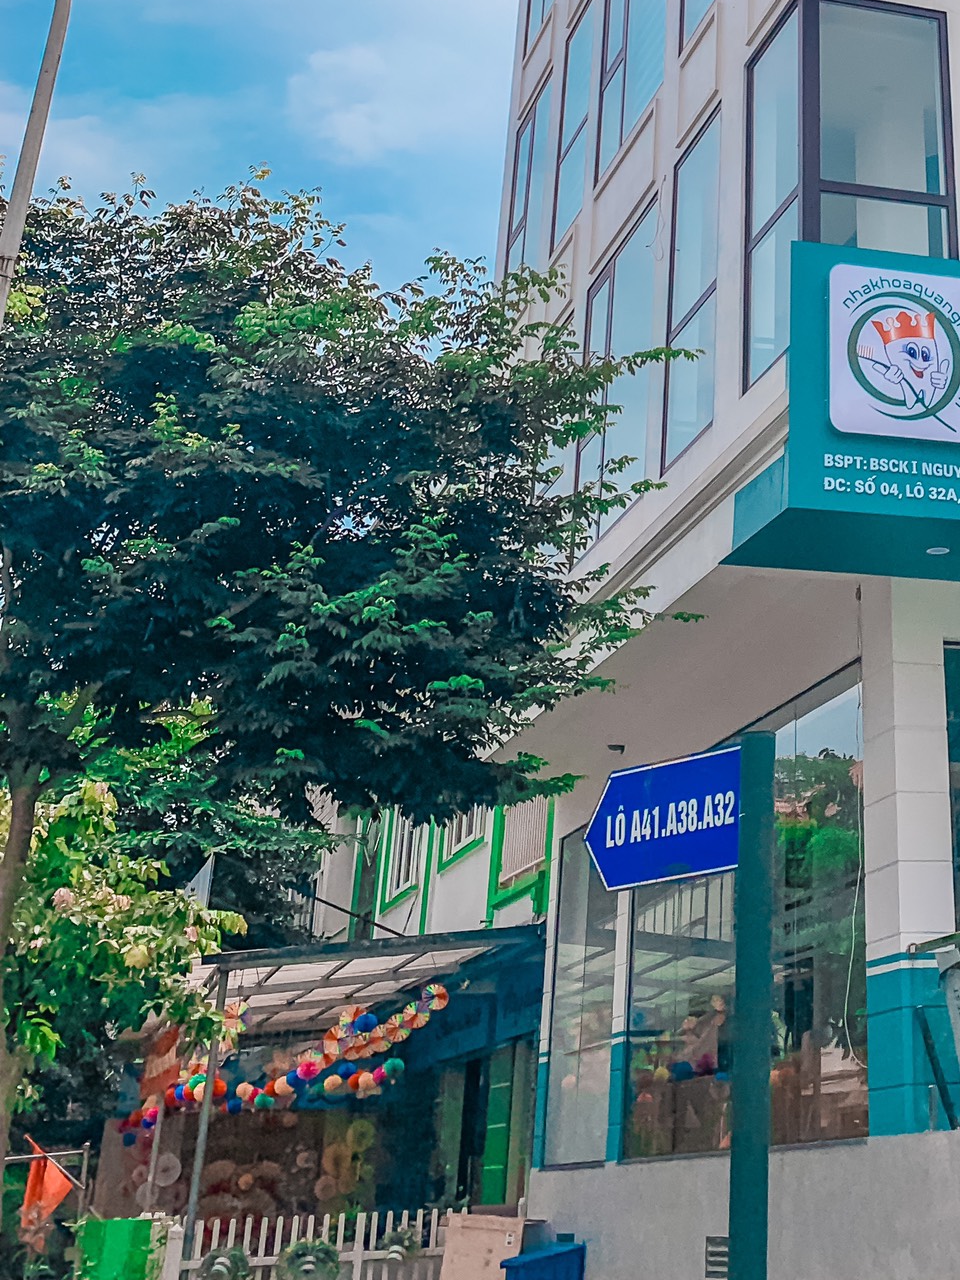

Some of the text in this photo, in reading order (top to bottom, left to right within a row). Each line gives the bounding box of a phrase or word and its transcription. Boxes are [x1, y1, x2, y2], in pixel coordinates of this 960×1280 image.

[824, 453, 867, 470] BSPT:
[870, 457, 909, 473] BSCK
[823, 476, 851, 493] ĐC:
[854, 475, 877, 495] SỐ
[880, 482, 903, 499] 04,
[906, 481, 925, 499] LÔ
[606, 791, 735, 848] LÔ A41.A38.A32
